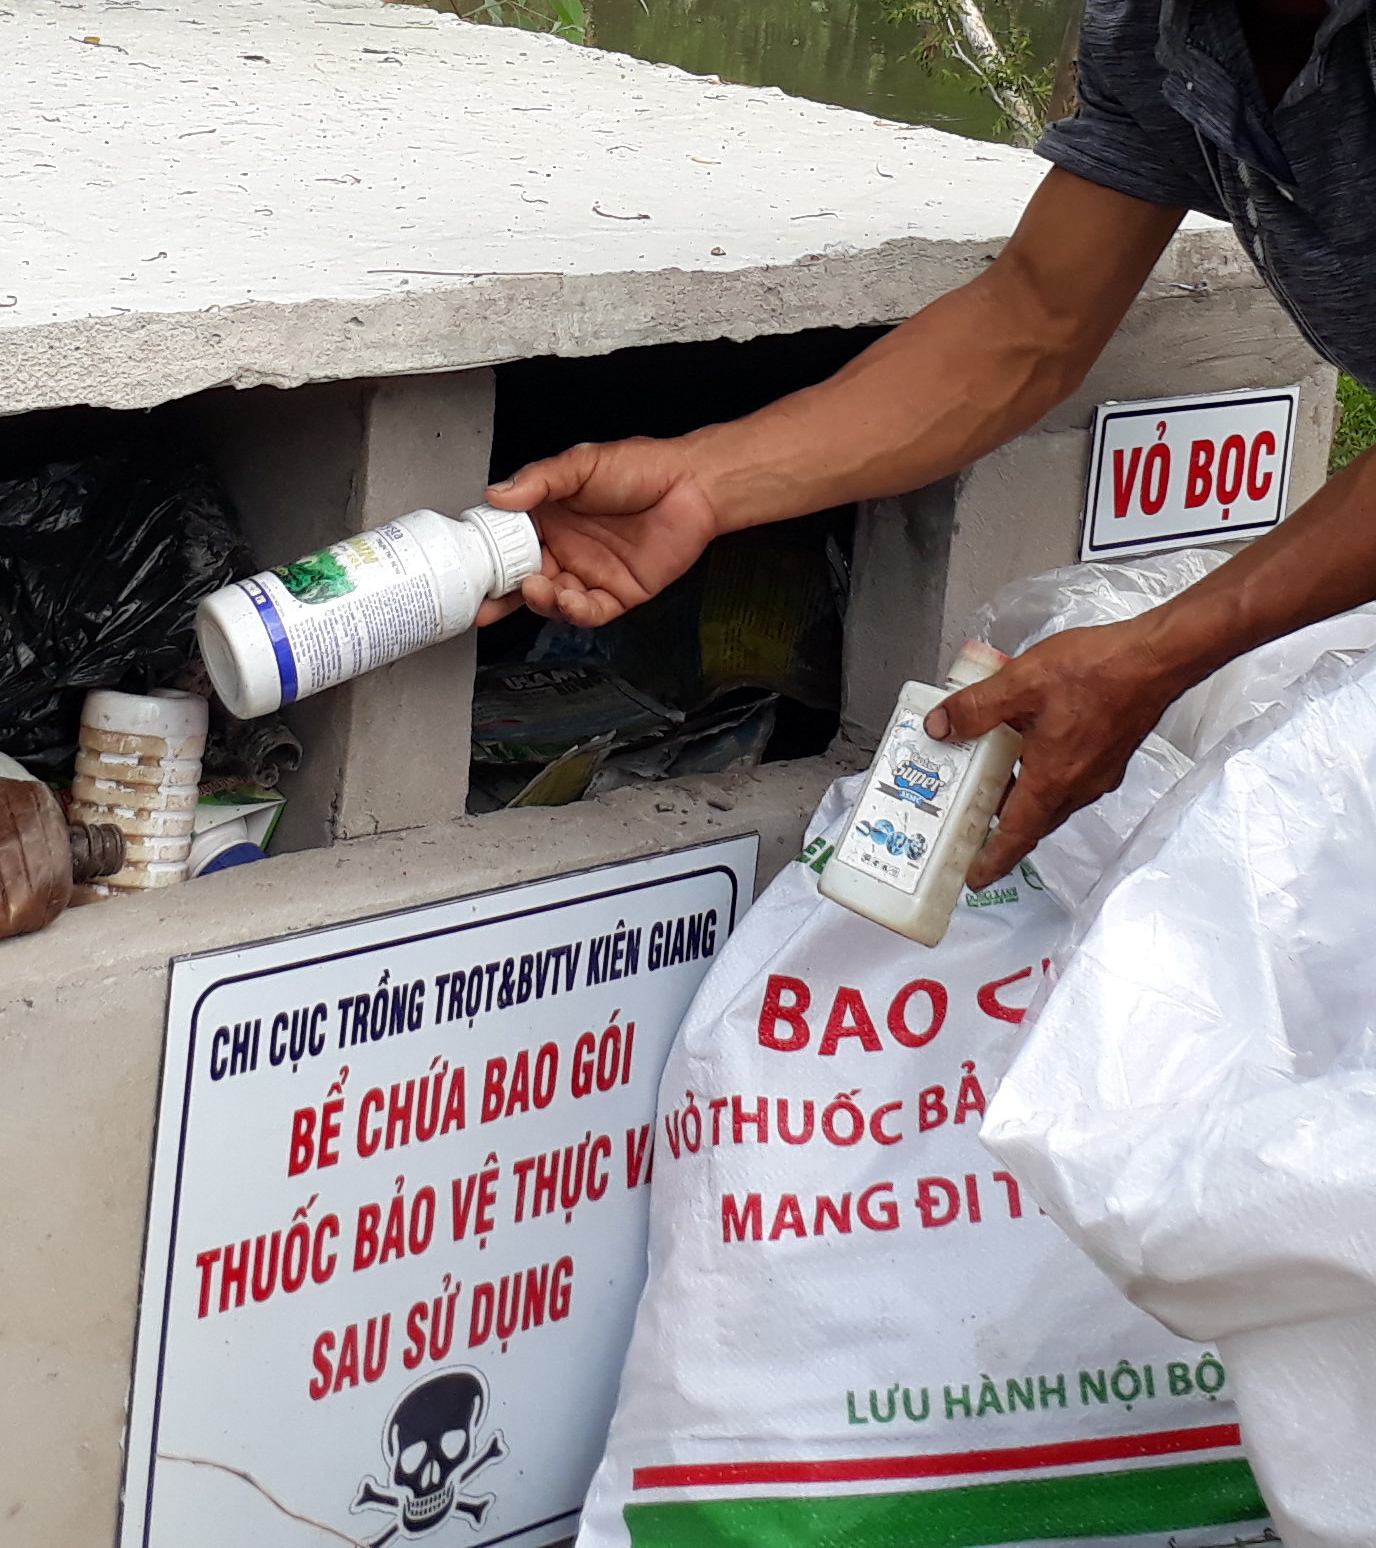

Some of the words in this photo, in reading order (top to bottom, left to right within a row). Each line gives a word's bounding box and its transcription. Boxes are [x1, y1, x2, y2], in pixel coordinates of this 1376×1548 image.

[1113, 420, 1171, 519] VỎ
[1183, 430, 1276, 521] BỌC
[891, 757, 946, 794] Super
[209, 1018, 262, 1082] CHI
[269, 1002, 328, 1073] CỤC
[337, 968, 426, 1049] TRỒNG
[434, 941, 583, 1030] TRỌT&BVTV
[586, 919, 641, 987] KIÊN
[647, 908, 718, 972] GIANG
[756, 972, 950, 1057] BAO
[976, 957, 1052, 1025] C
[287, 1065, 351, 1178] BỂ
[354, 1052, 467, 1160] CHỨA
[478, 1040, 560, 1126] BAO
[570, 1009, 636, 1099] GÓI
[664, 1088, 703, 1161] VỎ
[707, 1086, 905, 1149] THUỐC
[917, 1059, 986, 1134] BẢ
[193, 1191, 341, 1321] THUỐC
[351, 1174, 439, 1274] BẢO
[448, 1151, 502, 1251] VỆ
[511, 1130, 613, 1225] THỰC
[624, 1122, 656, 1191] V
[720, 1178, 901, 1244] MANG
[914, 1172, 983, 1228] ĐI
[992, 1169, 1048, 1222] T
[307, 1312, 392, 1403] SAU
[401, 1271, 464, 1372] SỬ
[467, 1254, 576, 1355] DỤNG
[845, 1385, 931, 1426] LƯU
[942, 1367, 1066, 1420] HÀNH
[1078, 1354, 1157, 1414] NỘI
[1167, 1349, 1227, 1404] BỘ
